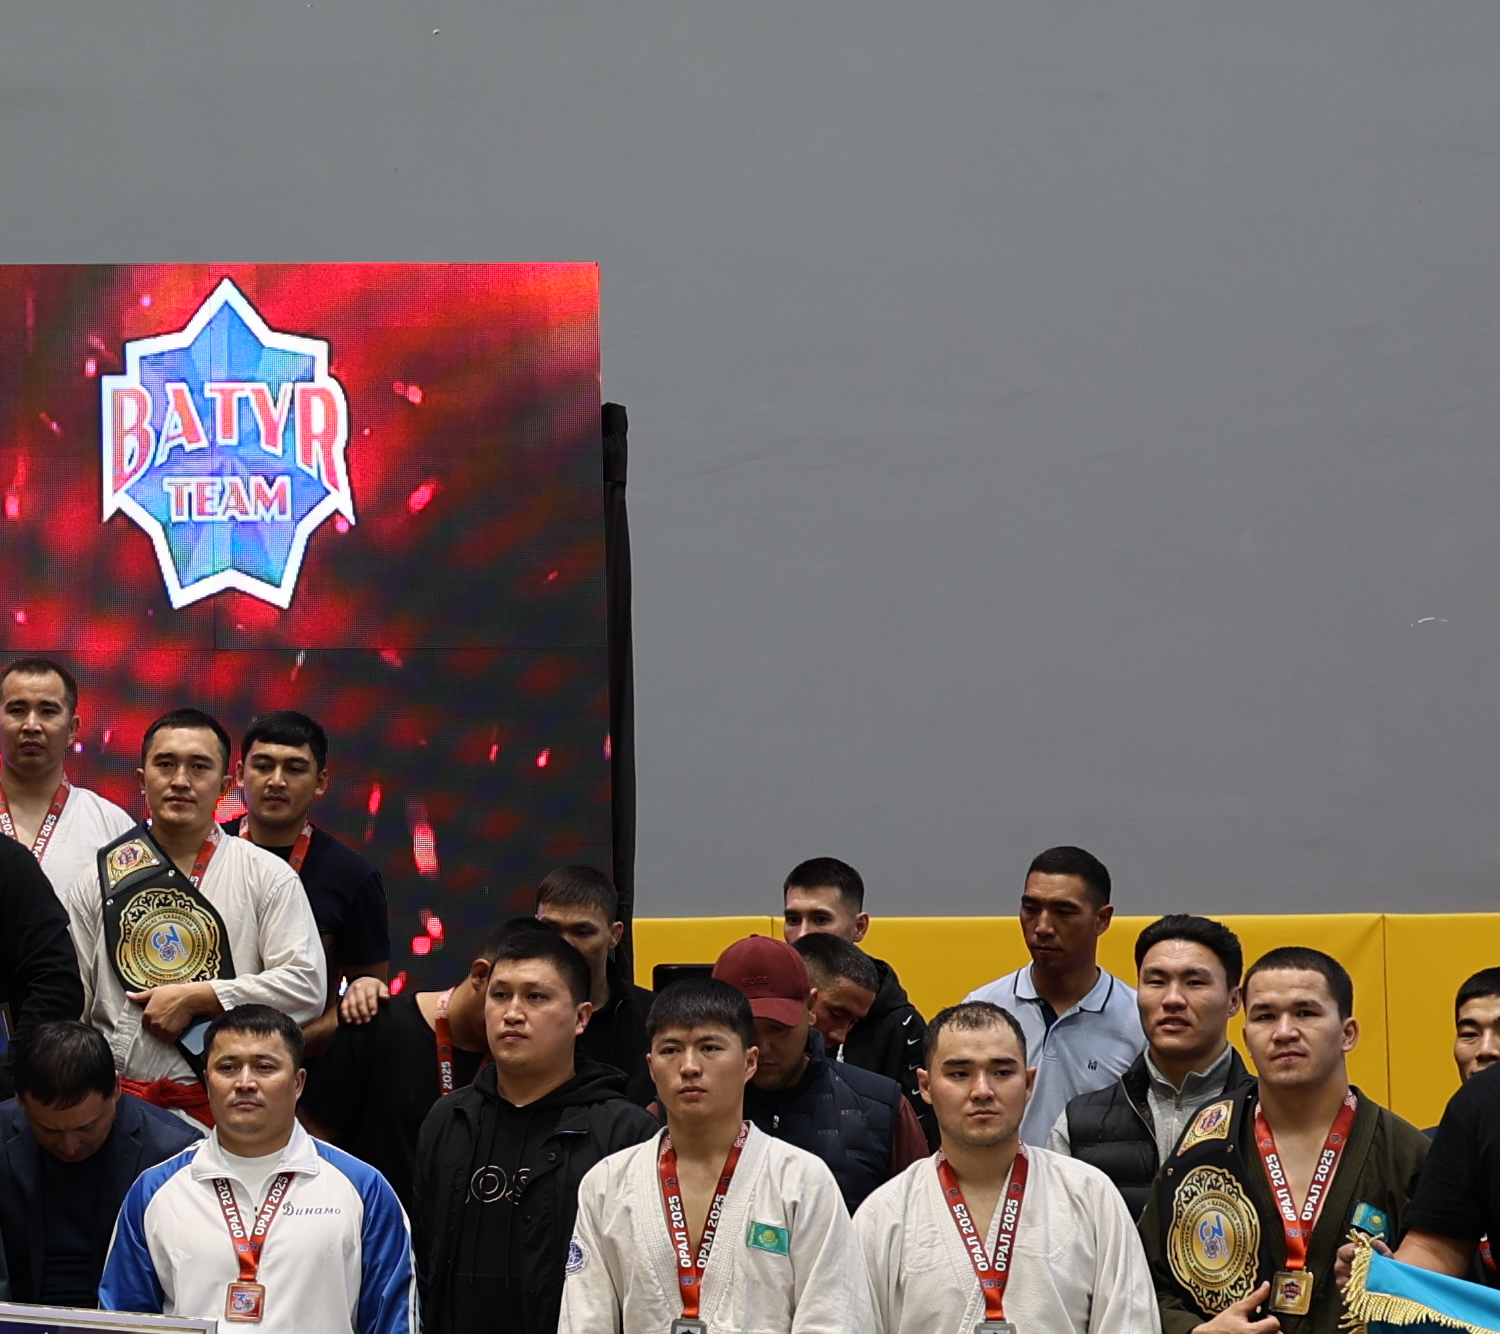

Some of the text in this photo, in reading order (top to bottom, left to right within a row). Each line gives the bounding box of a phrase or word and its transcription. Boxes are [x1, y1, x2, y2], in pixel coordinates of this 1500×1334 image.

[110, 380, 344, 496] BATYR
[163, 475, 292, 524] TEAM
[0, 812, 15, 838] 2025
[32, 813, 58, 860] РАЛ 2025
[440, 1061, 453, 1090] 2025
[215, 1177, 244, 1239] ОРАЛ 2025
[254, 1175, 289, 1237] ОРАЛ 2025
[282, 1200, 342, 1216] Динамо
[1264, 1153, 1297, 1222] ОРАЛ 2025
[1301, 1149, 1336, 1222] ОРАЛ 2025
[667, 1194, 693, 1268] ОРАЛ 2025
[696, 1193, 727, 1269] ОРАЛ 2025
[952, 1203, 989, 1272] ОРАЛ 2025
[994, 1198, 1019, 1272] ОРАЛ 2025
